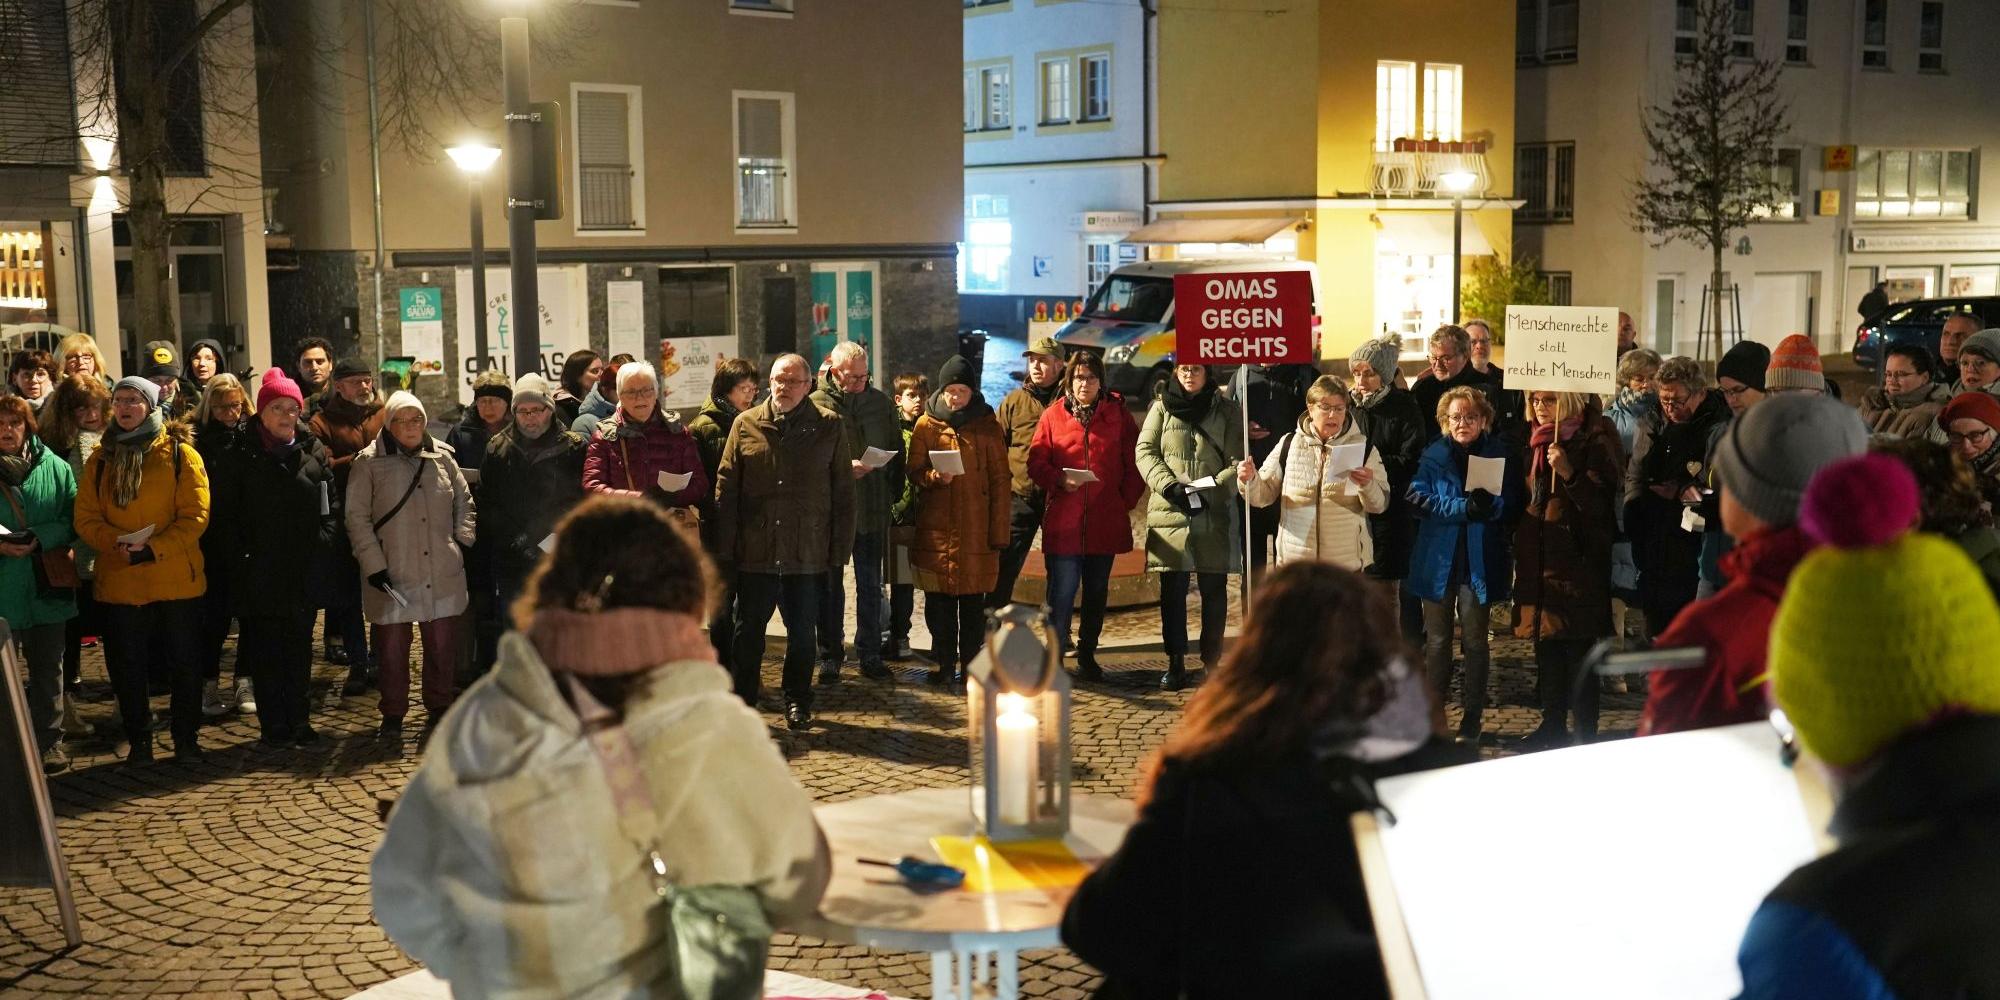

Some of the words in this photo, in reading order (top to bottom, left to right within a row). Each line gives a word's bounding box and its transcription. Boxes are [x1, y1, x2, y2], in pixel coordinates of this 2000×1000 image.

[1205, 278, 1278, 301] OMAS
[1201, 307, 1283, 330] GEGEN
[1508, 313, 1610, 333] Menschenrechte
[1199, 336, 1288, 359] RECHTS
[1538, 340, 1568, 353] statt
[1507, 361, 1546, 377] rechte
[1552, 361, 1611, 380] Menschen
